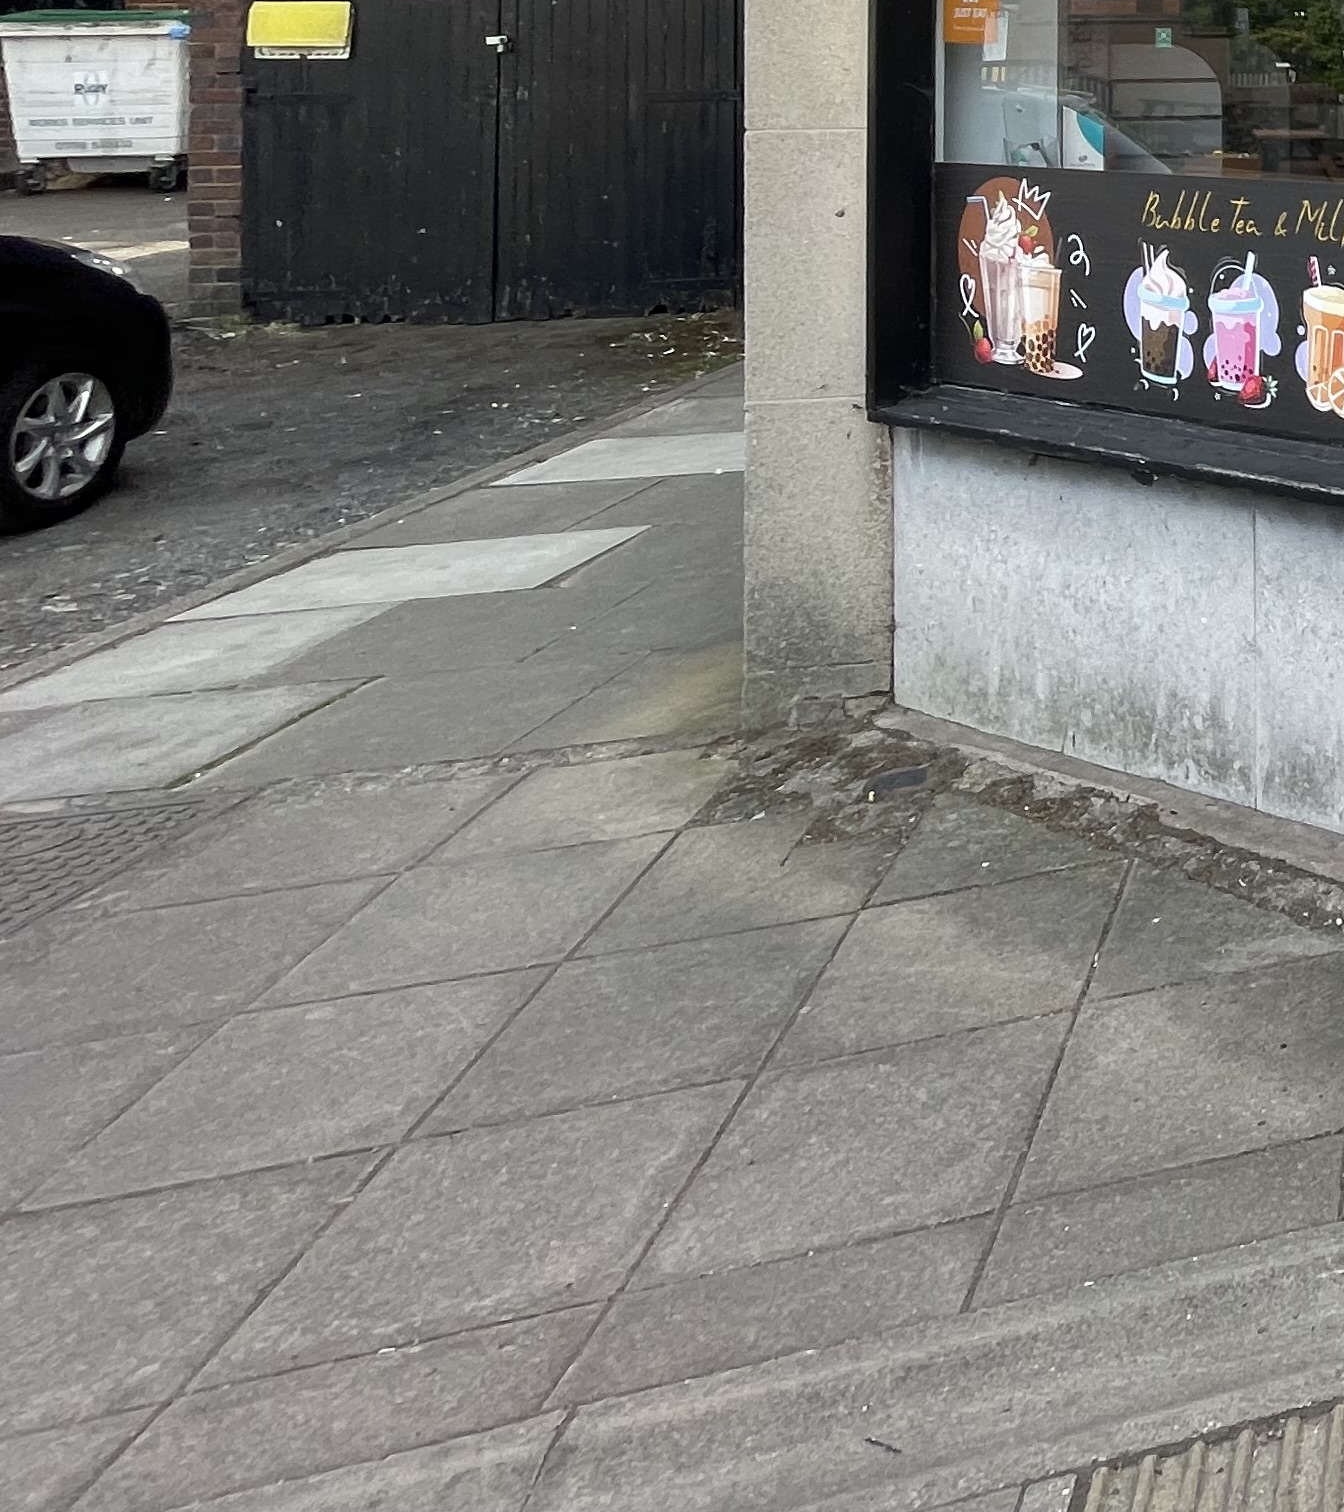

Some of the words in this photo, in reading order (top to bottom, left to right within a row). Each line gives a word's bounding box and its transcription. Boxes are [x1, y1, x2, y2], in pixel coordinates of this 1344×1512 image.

[1141, 189, 1220, 233] Bubble
[1230, 196, 1263, 237] Tea
[1274, 211, 1289, 237] &
